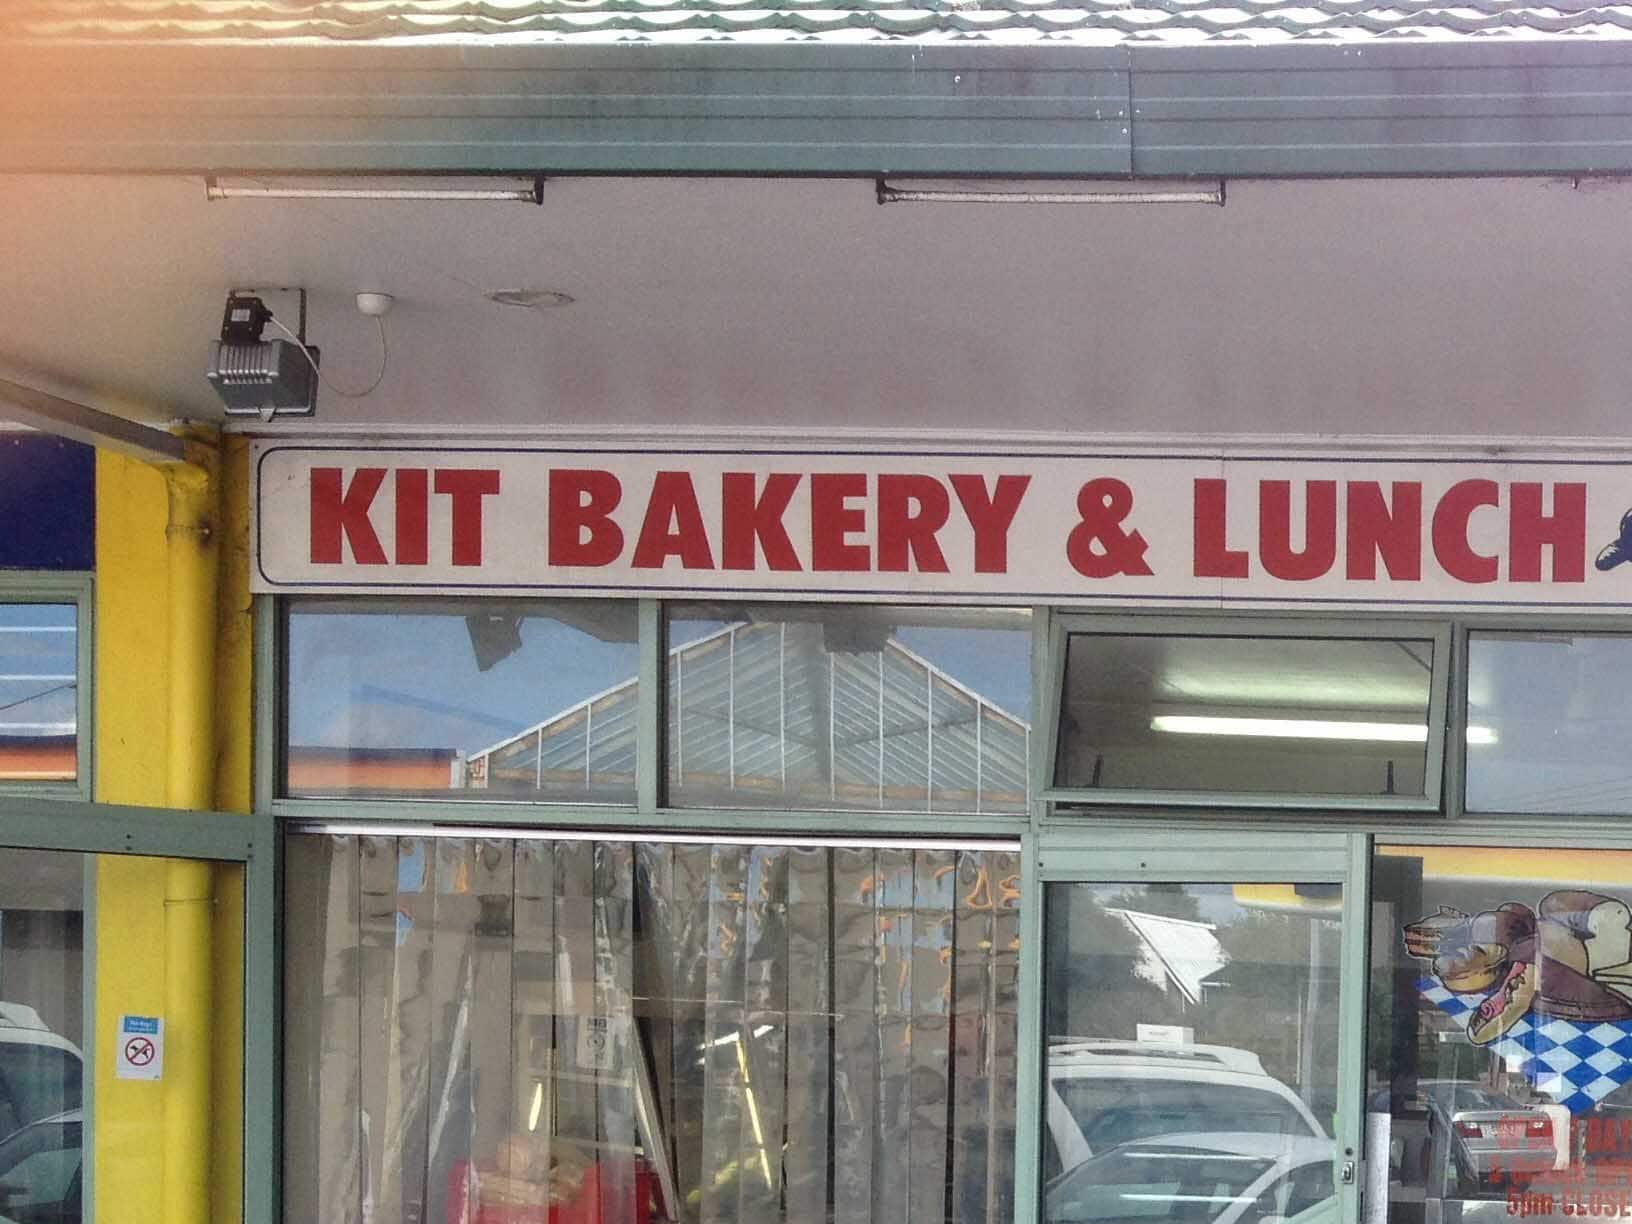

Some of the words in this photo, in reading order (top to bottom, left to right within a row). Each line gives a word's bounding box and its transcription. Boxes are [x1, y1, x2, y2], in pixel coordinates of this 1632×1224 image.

[312, 468, 501, 566] KIT
[549, 469, 1030, 574] BAKERY
[1068, 478, 1153, 578] &
[1194, 480, 1588, 584] LUNCH
[1561, 1188, 1632, 1218] CLOSE
